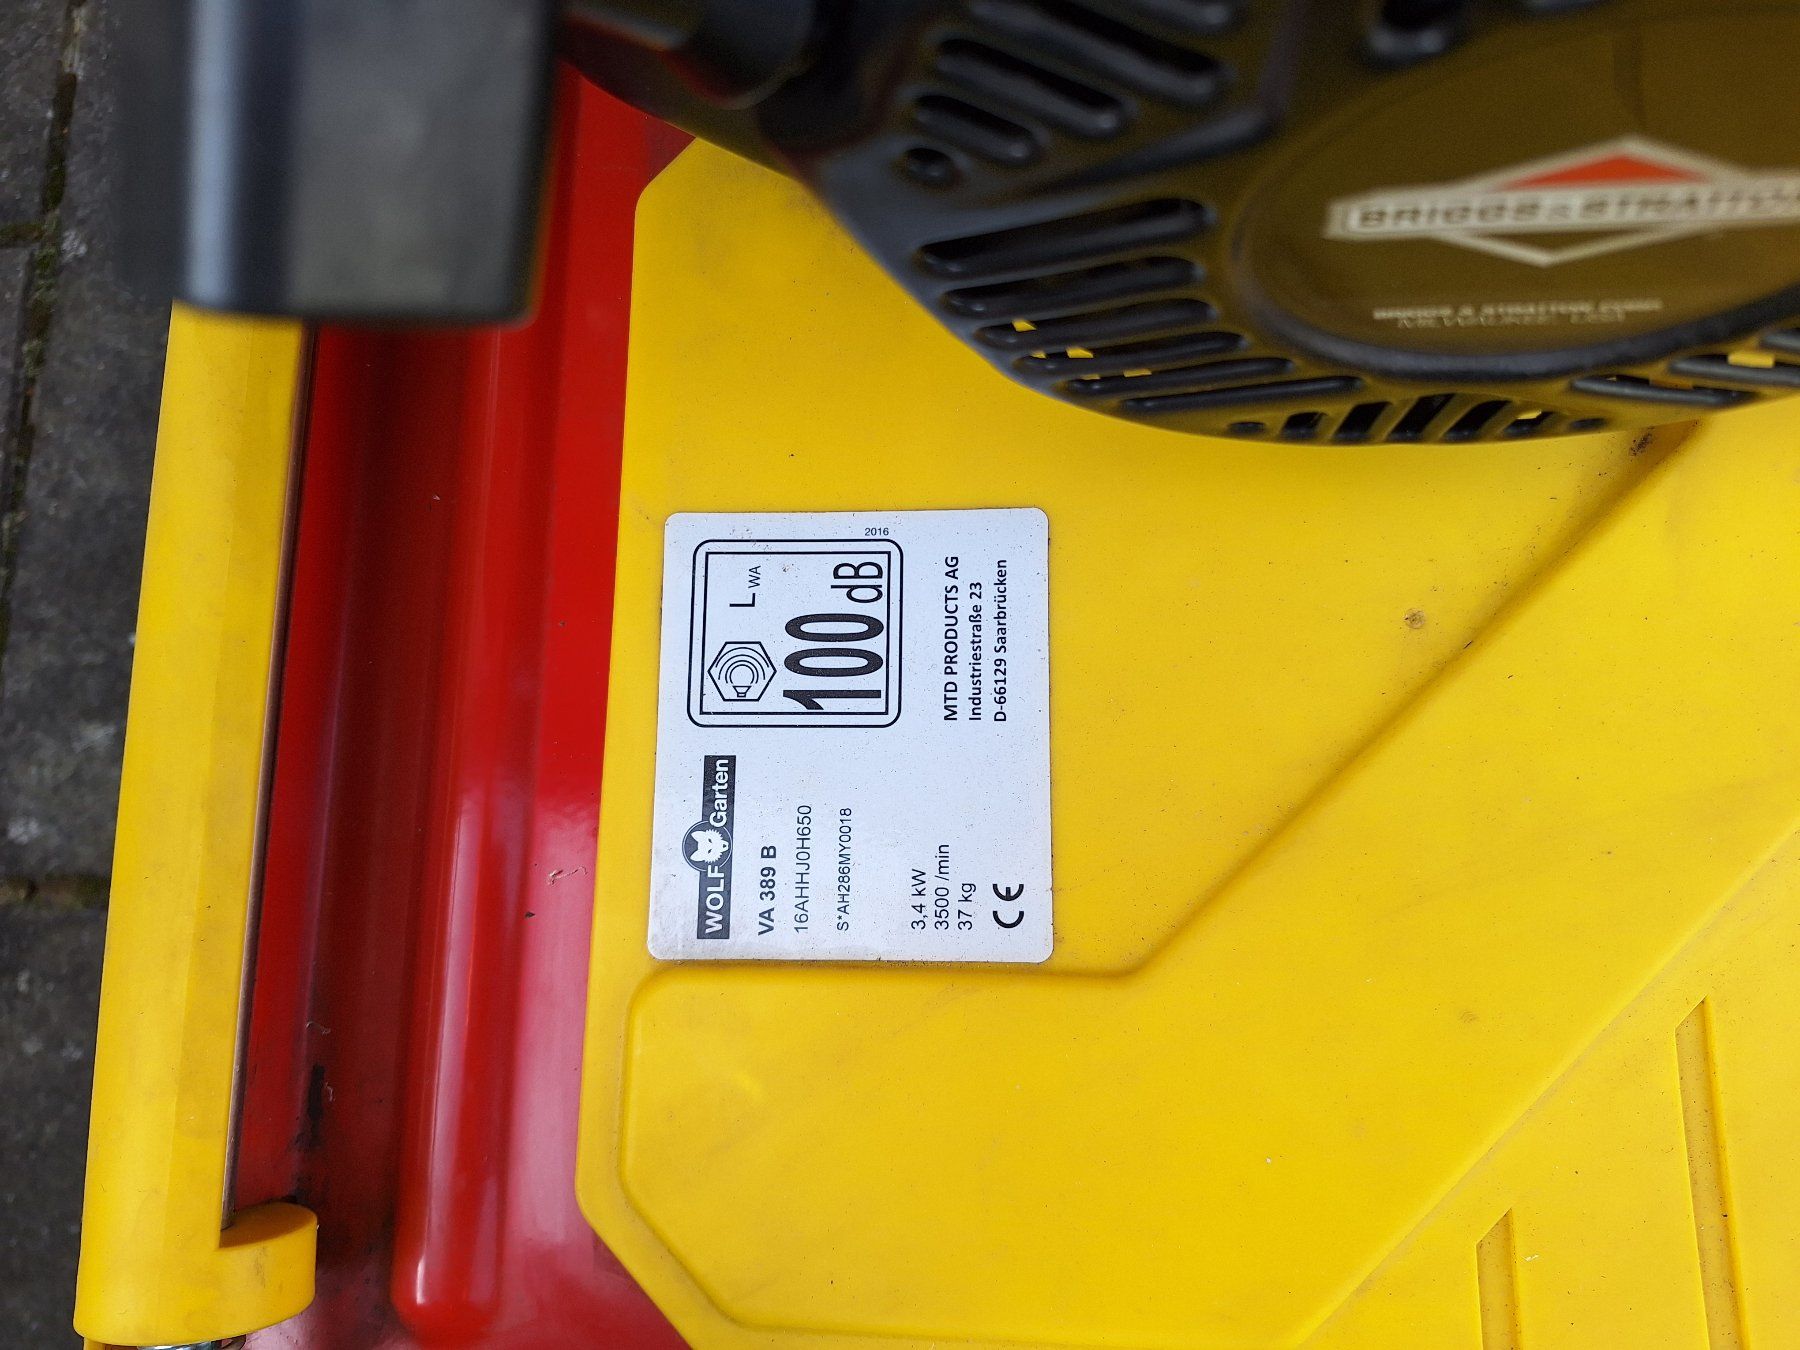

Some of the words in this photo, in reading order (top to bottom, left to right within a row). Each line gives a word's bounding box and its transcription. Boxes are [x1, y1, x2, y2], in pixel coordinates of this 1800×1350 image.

[864, 527, 890, 537] 2016
[830, 561, 884, 604] dB
[944, 556, 960, 579] AG
[969, 581, 983, 600] 23
[993, 559, 1007, 654] Saarbrücken
[943, 584, 959, 676] PRODUCTS
[782, 612, 885, 711] 100
[967, 604, 984, 722] Industriestraße
[943, 681, 958, 721] MTD
[993, 658, 1007, 722] D-66129
[709, 758, 730, 829] Garten
[760, 845, 777, 859] B
[793, 805, 812, 933] 16AHHJ0H650
[934, 844, 950, 882] /min
[704, 865, 727, 935] WOLF
[759, 866, 777, 901] 389
[911, 868, 927, 897] kW
[957, 882, 977, 903] kg
[757, 907, 775, 936] VA
[910, 903, 928, 930] 3,4
[934, 888, 950, 931] 3500
[957, 909, 973, 931] 37
